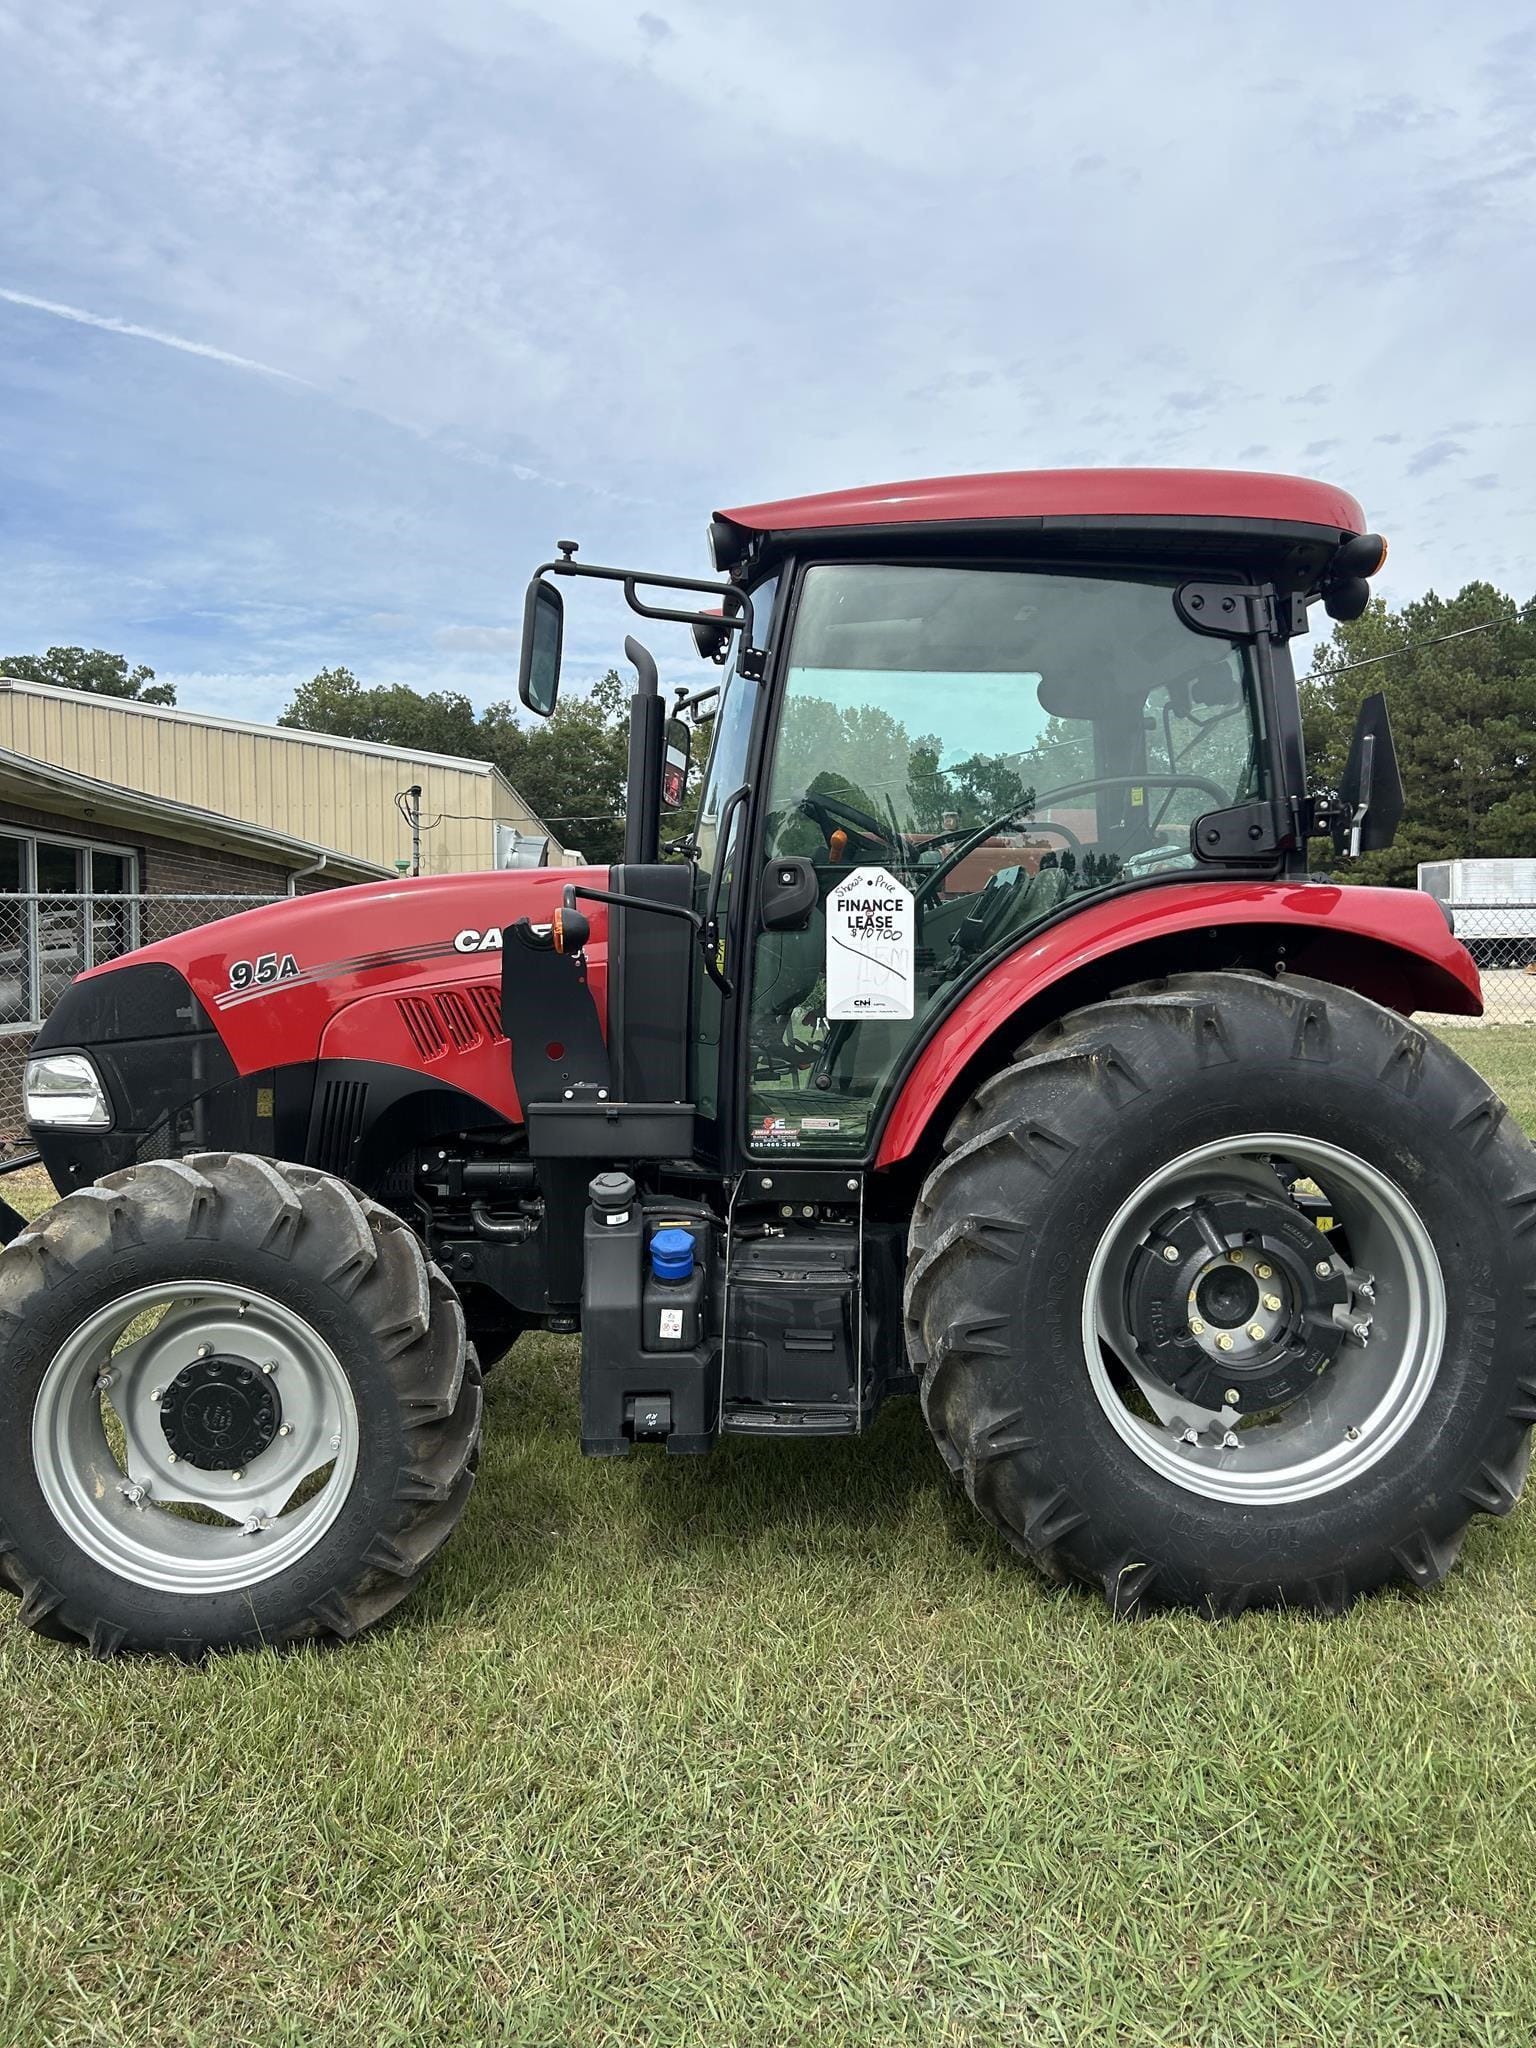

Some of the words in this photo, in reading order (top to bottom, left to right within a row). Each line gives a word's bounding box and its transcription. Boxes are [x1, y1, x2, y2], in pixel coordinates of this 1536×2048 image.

[875, 875, 896, 894] Price
[837, 899, 903, 912] FINANCE
[848, 916, 892, 929] LEASE
[229, 952, 300, 991] 95A
